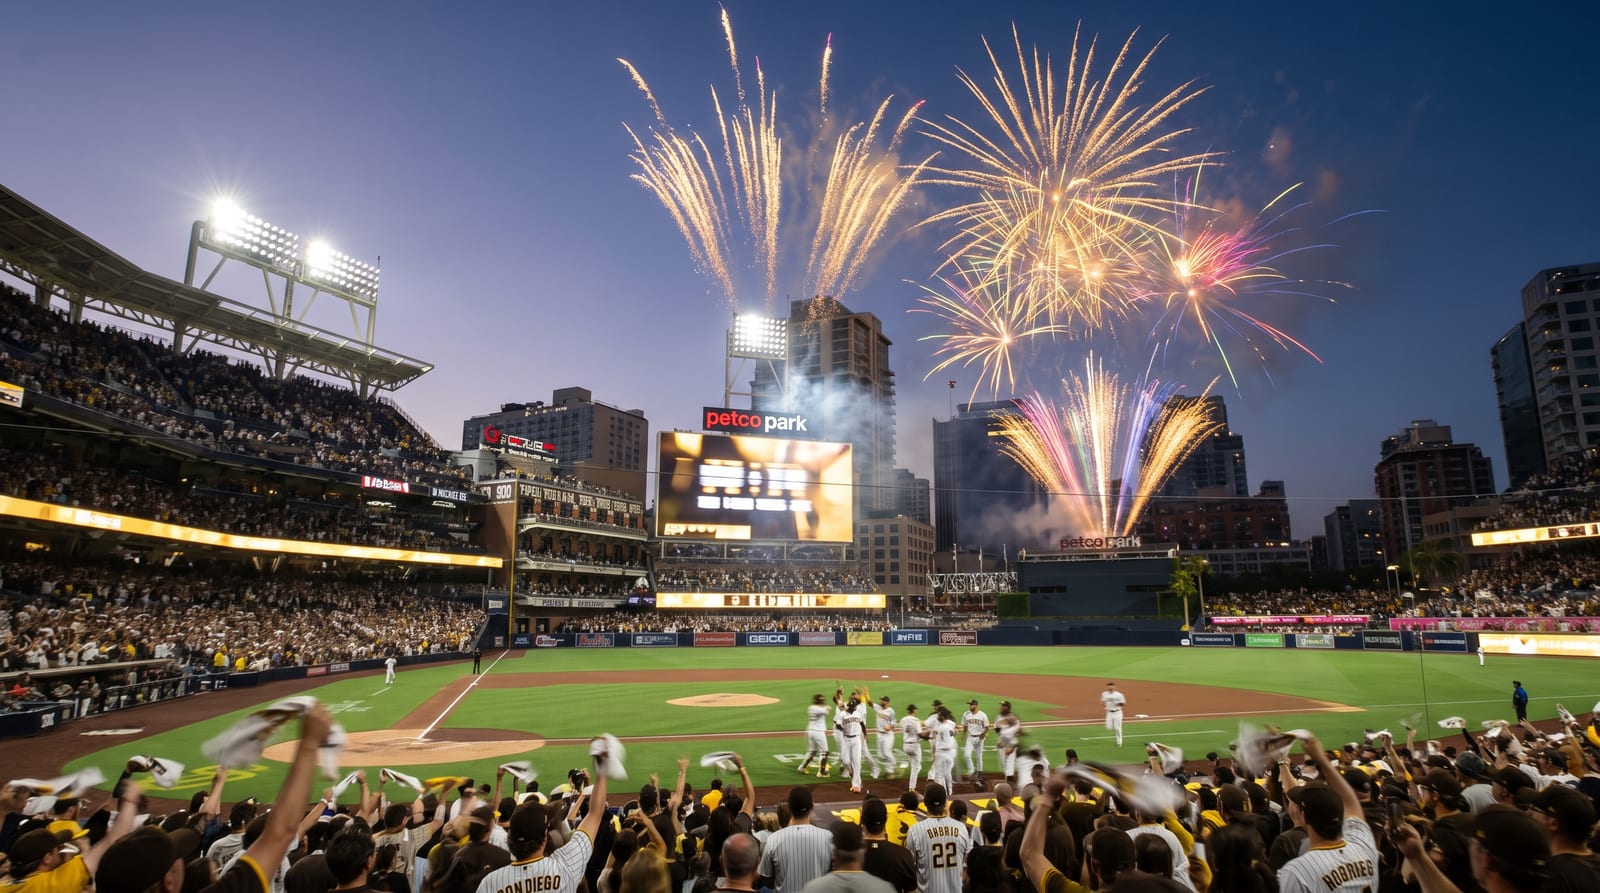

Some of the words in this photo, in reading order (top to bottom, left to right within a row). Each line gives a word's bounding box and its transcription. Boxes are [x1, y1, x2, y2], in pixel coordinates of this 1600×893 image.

[706, 410, 763, 429] petco
[765, 415, 807, 432] park
[1060, 536, 1103, 551] petco
[1106, 535, 1142, 549] park
[749, 635, 787, 643] GEICO
[932, 842, 957, 868] 22
[525, 875, 561, 893] DIEGO
